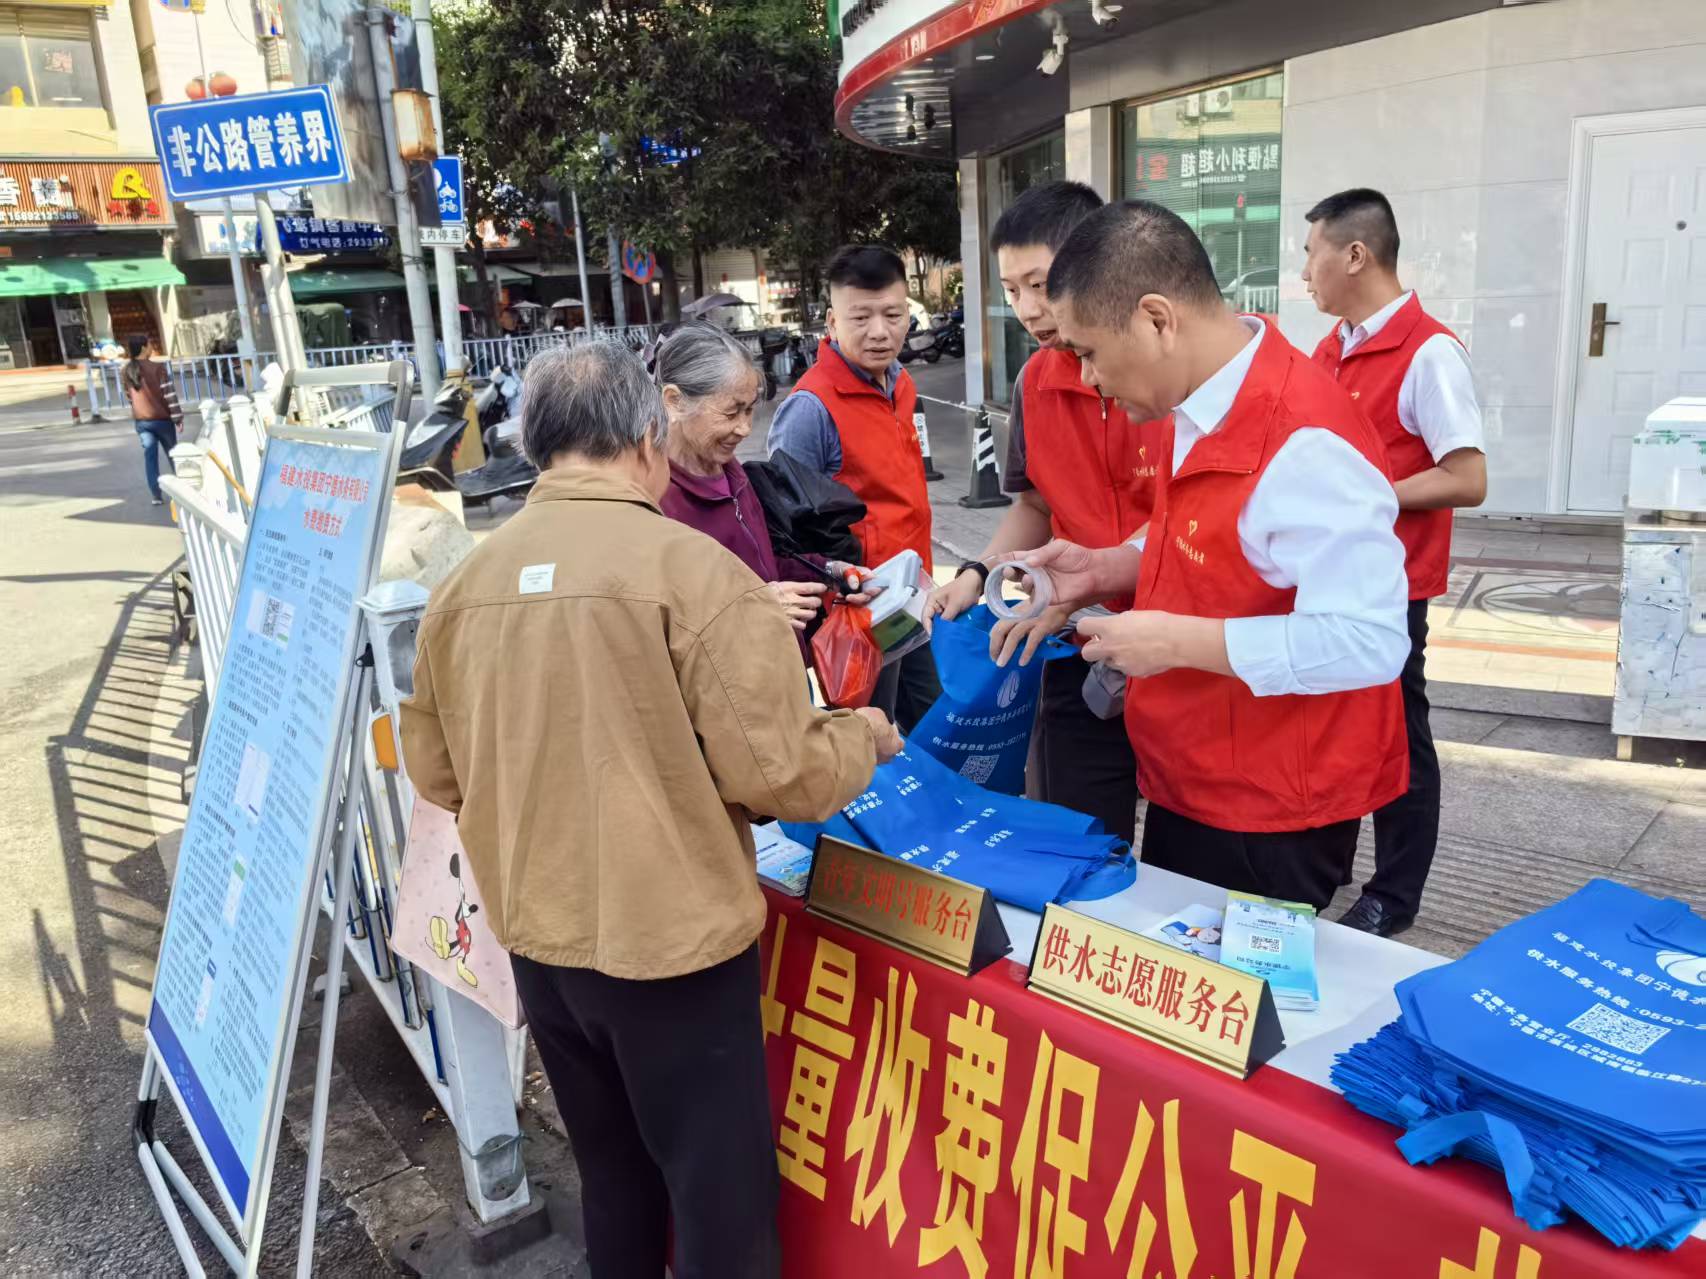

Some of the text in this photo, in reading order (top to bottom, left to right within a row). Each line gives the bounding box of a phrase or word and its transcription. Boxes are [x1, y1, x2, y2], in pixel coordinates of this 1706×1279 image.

[167, 110, 333, 177] 非公路管养界
[1043, 923, 1249, 1046] 供水志愿服务台
